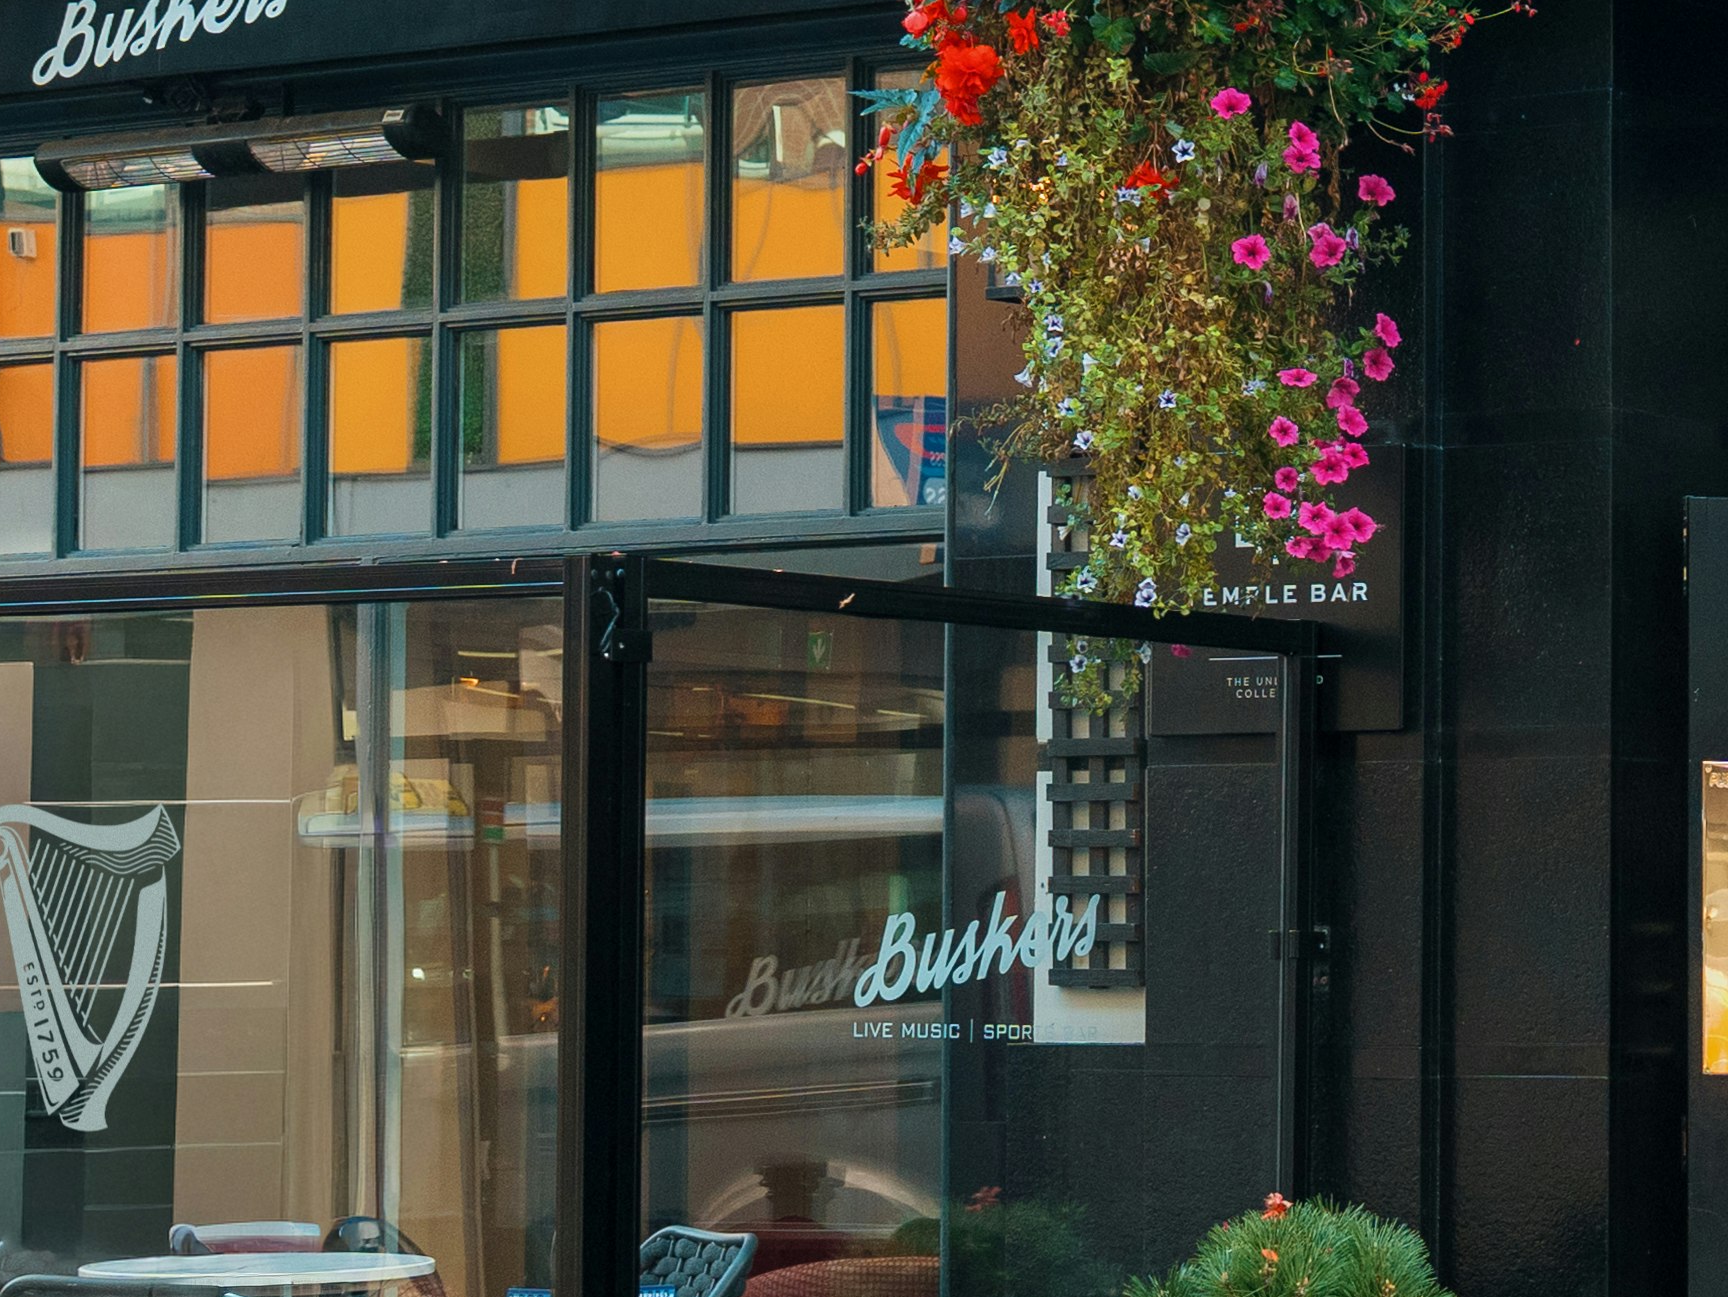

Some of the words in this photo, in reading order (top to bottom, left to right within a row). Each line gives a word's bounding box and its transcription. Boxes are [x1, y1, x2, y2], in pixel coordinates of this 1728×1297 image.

[1202, 584, 1298, 607] EMPLE
[1310, 582, 1369, 603] BAR
[1226, 676, 1250, 687] THE
[1235, 688, 1276, 699] COLLE
[854, 890, 1101, 1008] Buskers
[852, 1022, 893, 1038] LIVE
[901, 1023, 961, 1039] MUSIC
[34, 1018, 64, 1082] 1759
